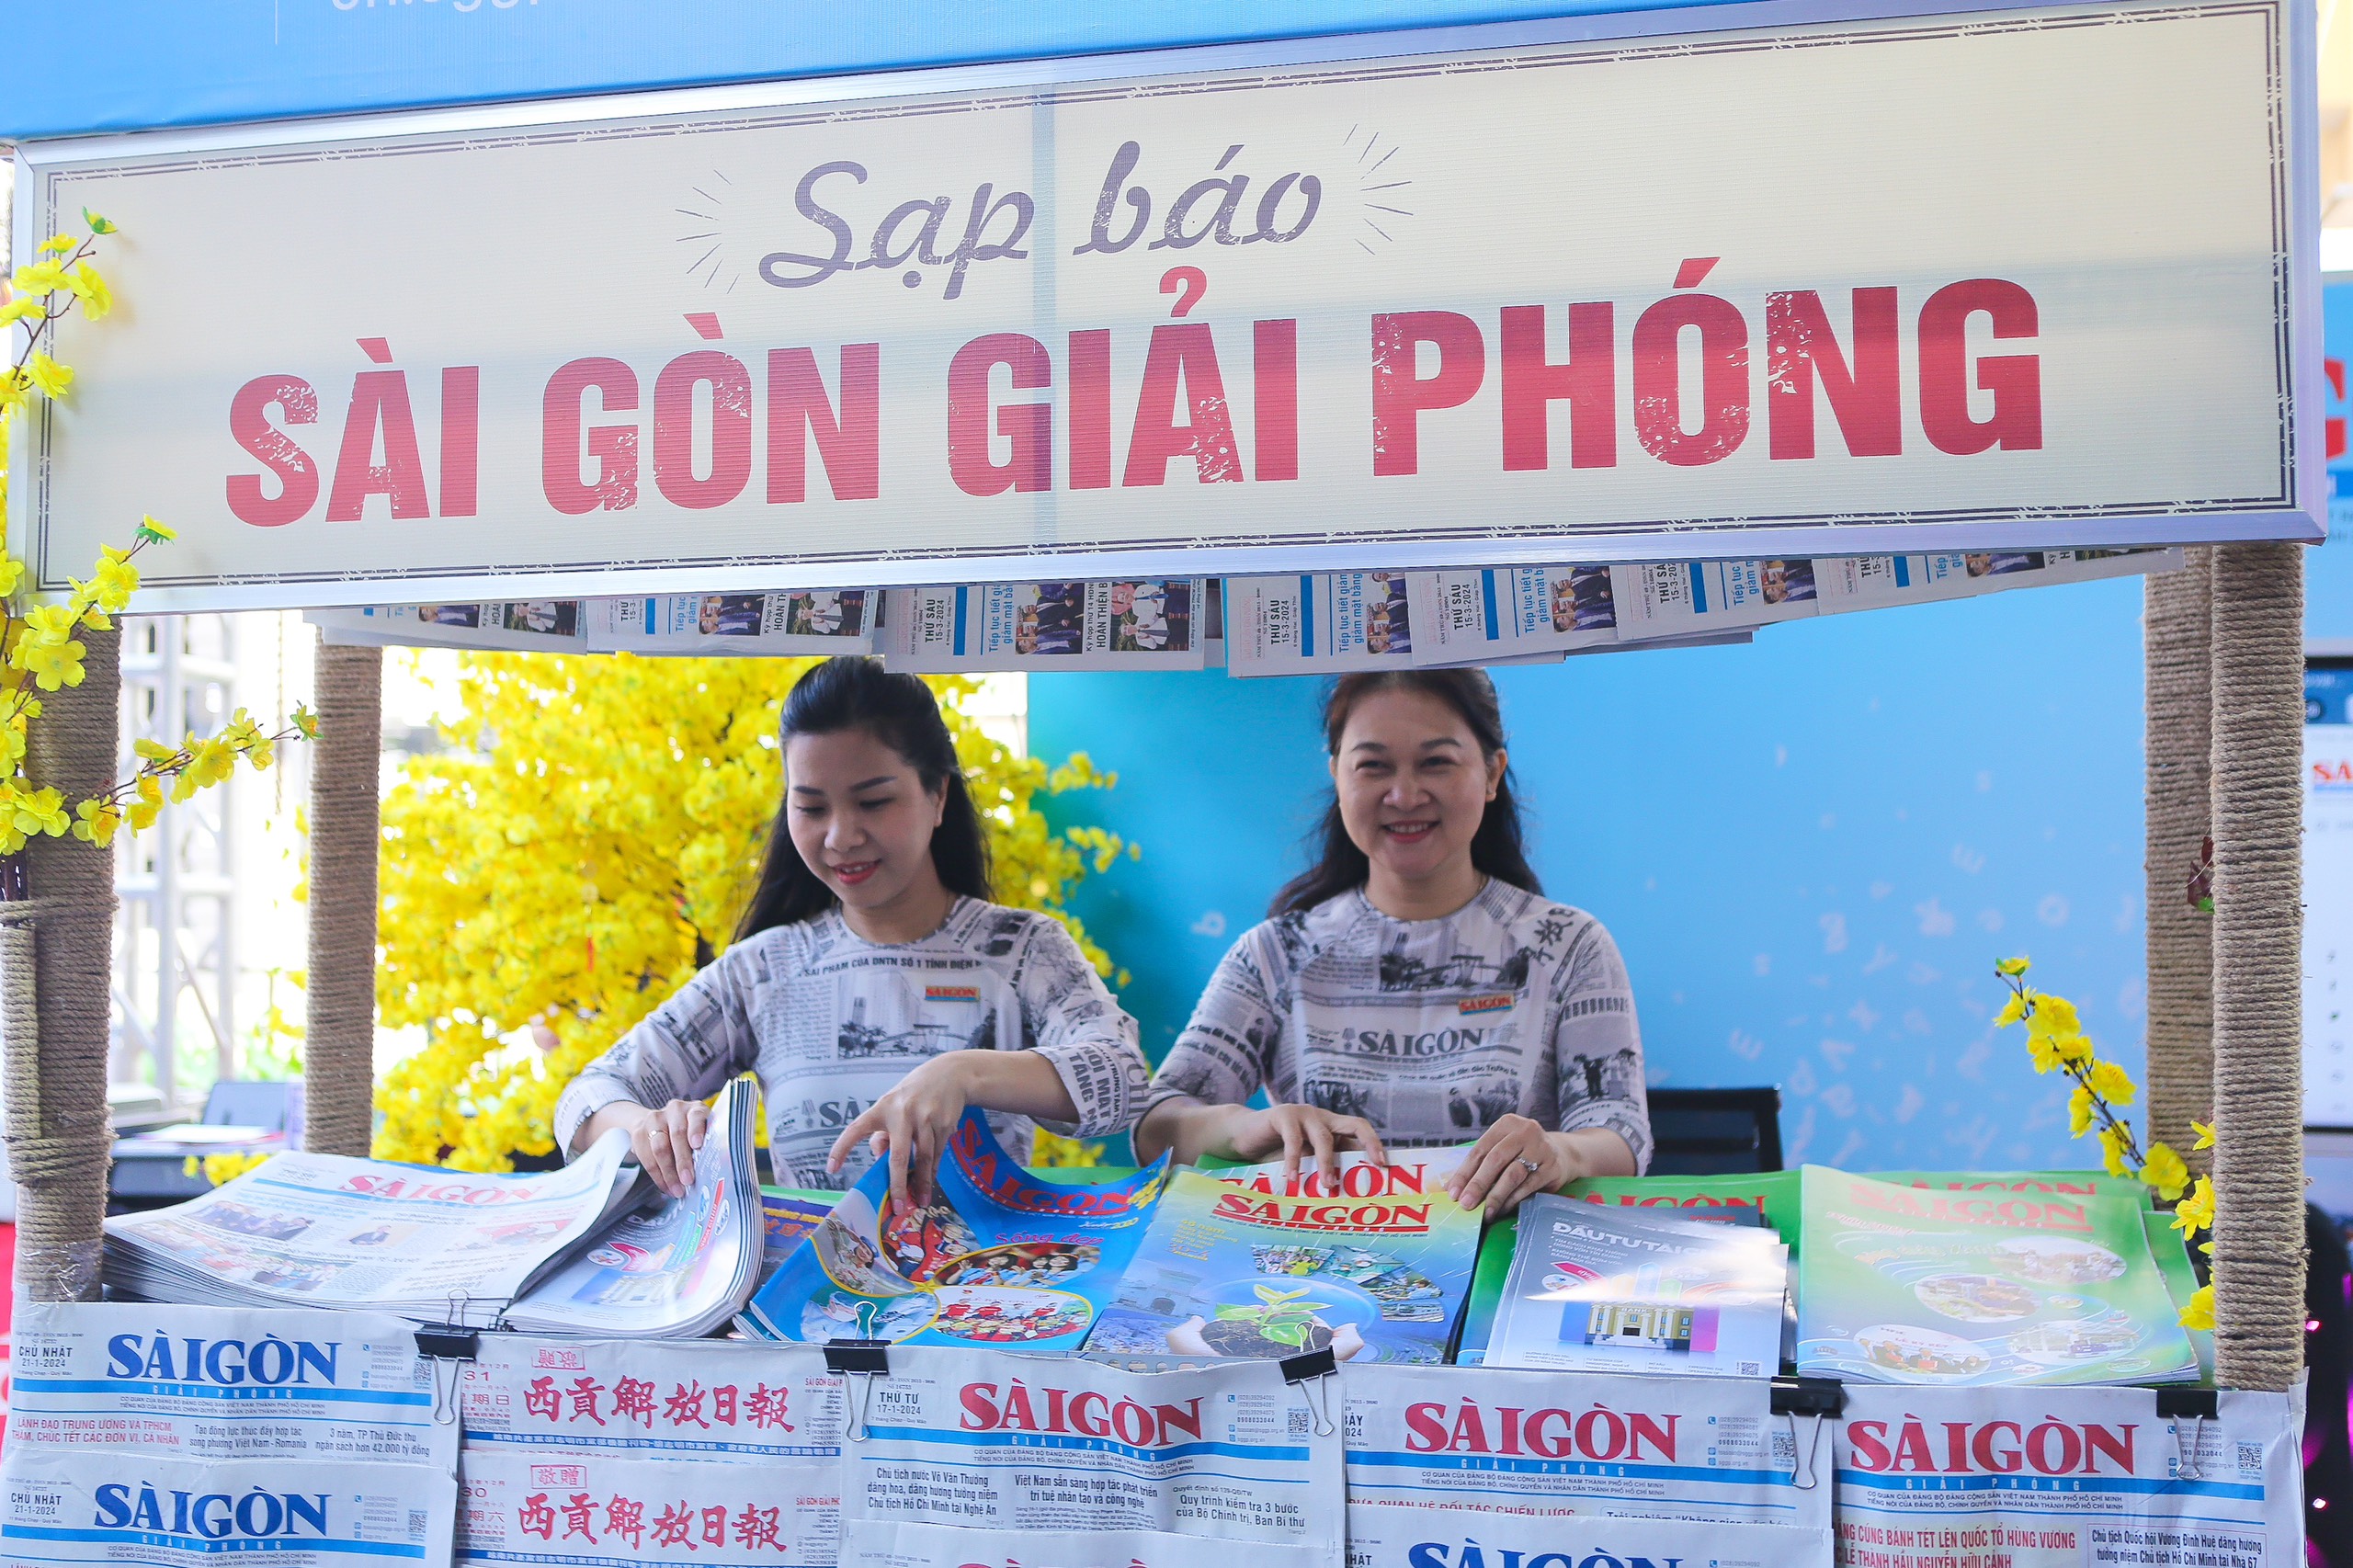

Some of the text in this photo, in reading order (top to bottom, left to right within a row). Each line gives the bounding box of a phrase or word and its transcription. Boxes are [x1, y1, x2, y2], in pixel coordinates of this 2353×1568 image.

[758, 140, 1321, 300] Sạp báo
[225, 257, 2043, 528] SÀI GÒN GIẢI PHÓNG
[936, 599, 944, 641] 15-3-2024
[1095, 591, 1109, 648] HOÀN THIỆN
[1281, 600, 1290, 642] 15-3-2024
[1462, 584, 1473, 628] 15-3-2024
[1218, 1193, 1434, 1226] SÀIGÒN
[21, 1358, 66, 1369] 21-1-2024
[107, 1328, 343, 1386] SÀIGÒN
[523, 1375, 795, 1433] 西貢解放日報
[877, 1404, 921, 1415] 17-1-2024
[880, 1391, 902, 1403] THỨ
[960, 1377, 1205, 1447] SÀIGÒN
[62, 1419, 95, 1430] TRUNG
[1404, 1396, 1682, 1463] SÀIGÒN
[1847, 1413, 2140, 1475] SÀIGÒN
[1033, 1474, 1051, 1486] Nam
[14, 1505, 56, 1515] 21-1-2024
[94, 1480, 333, 1539] SÀIGÒN
[517, 1493, 787, 1552] 西貢解放日報
[931, 1500, 949, 1513] Minh
[1176, 1506, 1194, 1517] của
[1256, 1515, 1273, 1526] Ban
[1180, 1494, 1199, 1506] Quy
[1249, 1501, 1262, 1513] tra
[1265, 1502, 1271, 1513] 3
[1858, 1522, 2075, 1550] CÚNG BÁNH TÉT LÊN QUỐC TỔ HÙNG VƯƠNG
